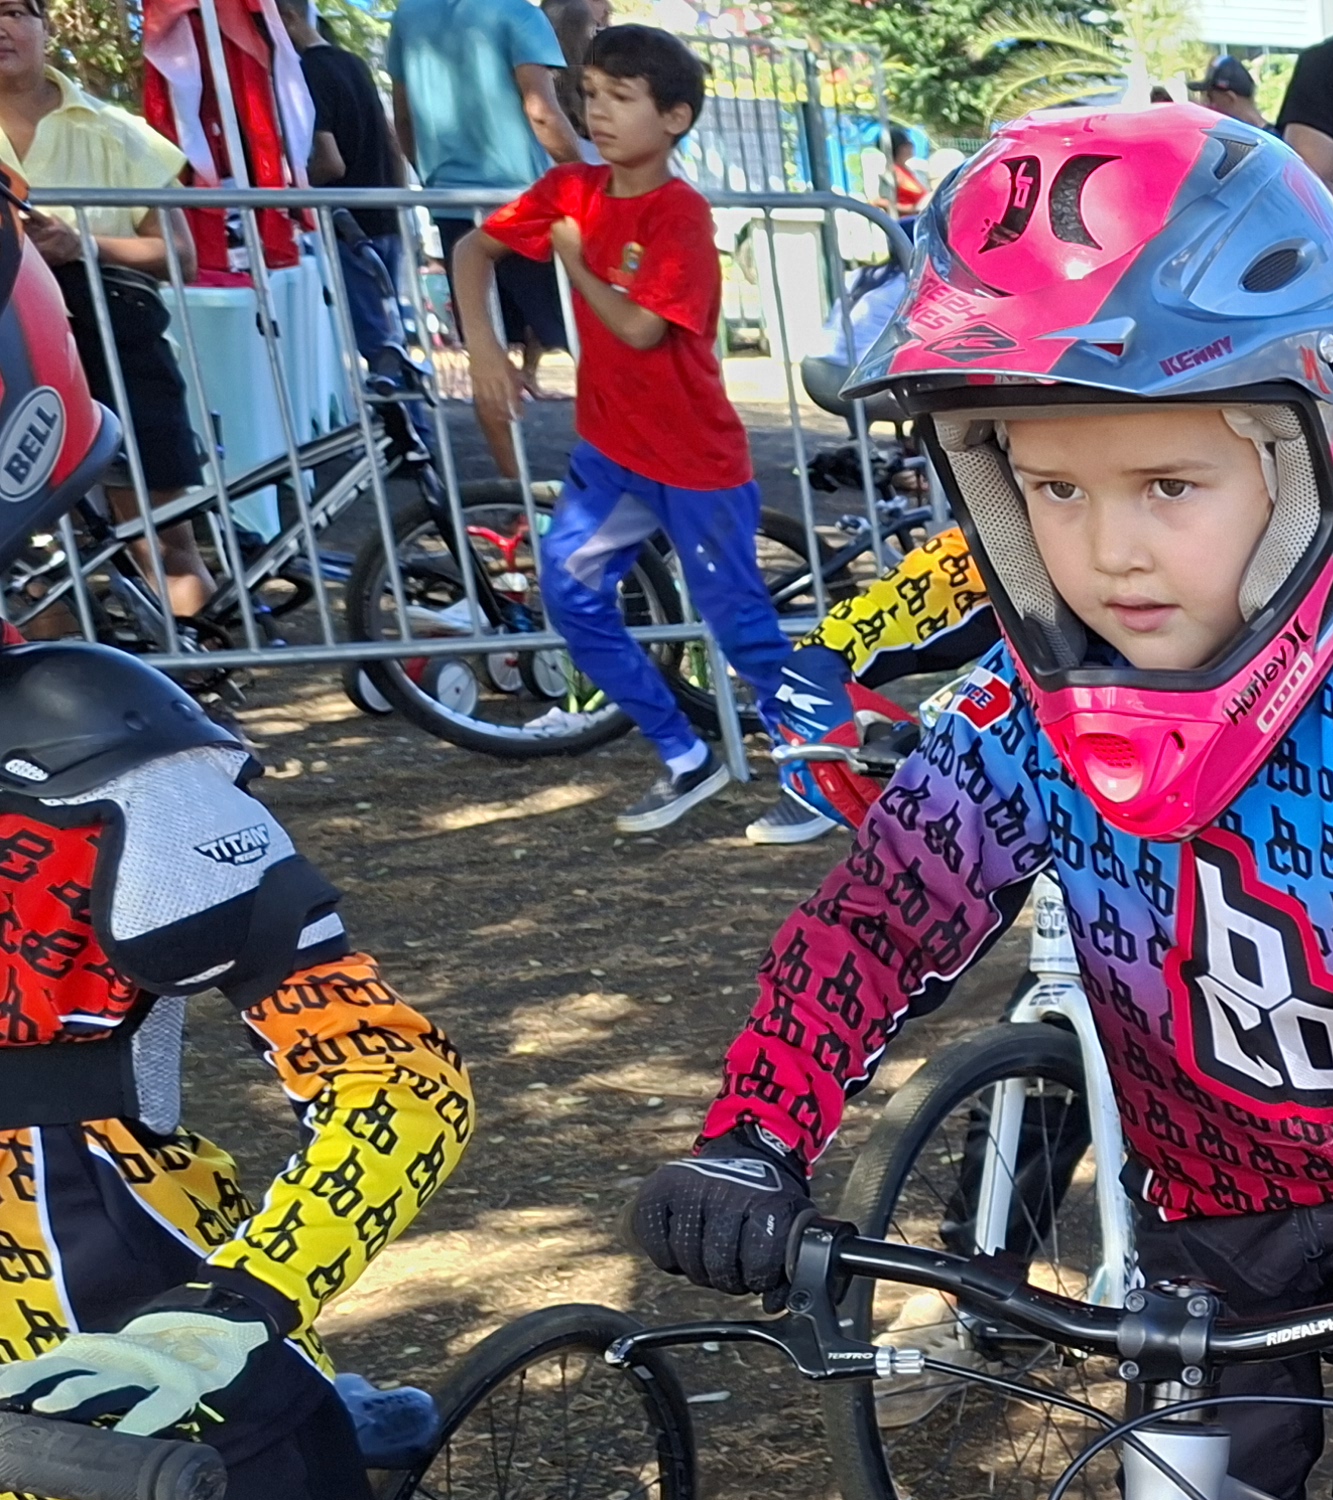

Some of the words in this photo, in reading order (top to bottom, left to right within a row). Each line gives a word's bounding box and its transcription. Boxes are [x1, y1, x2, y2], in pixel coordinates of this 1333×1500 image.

[1158, 334, 1235, 378] KENNY
[2, 405, 59, 486] BELL
[1224, 645, 1288, 727] Hurley
[198, 826, 269, 861] TITAN
